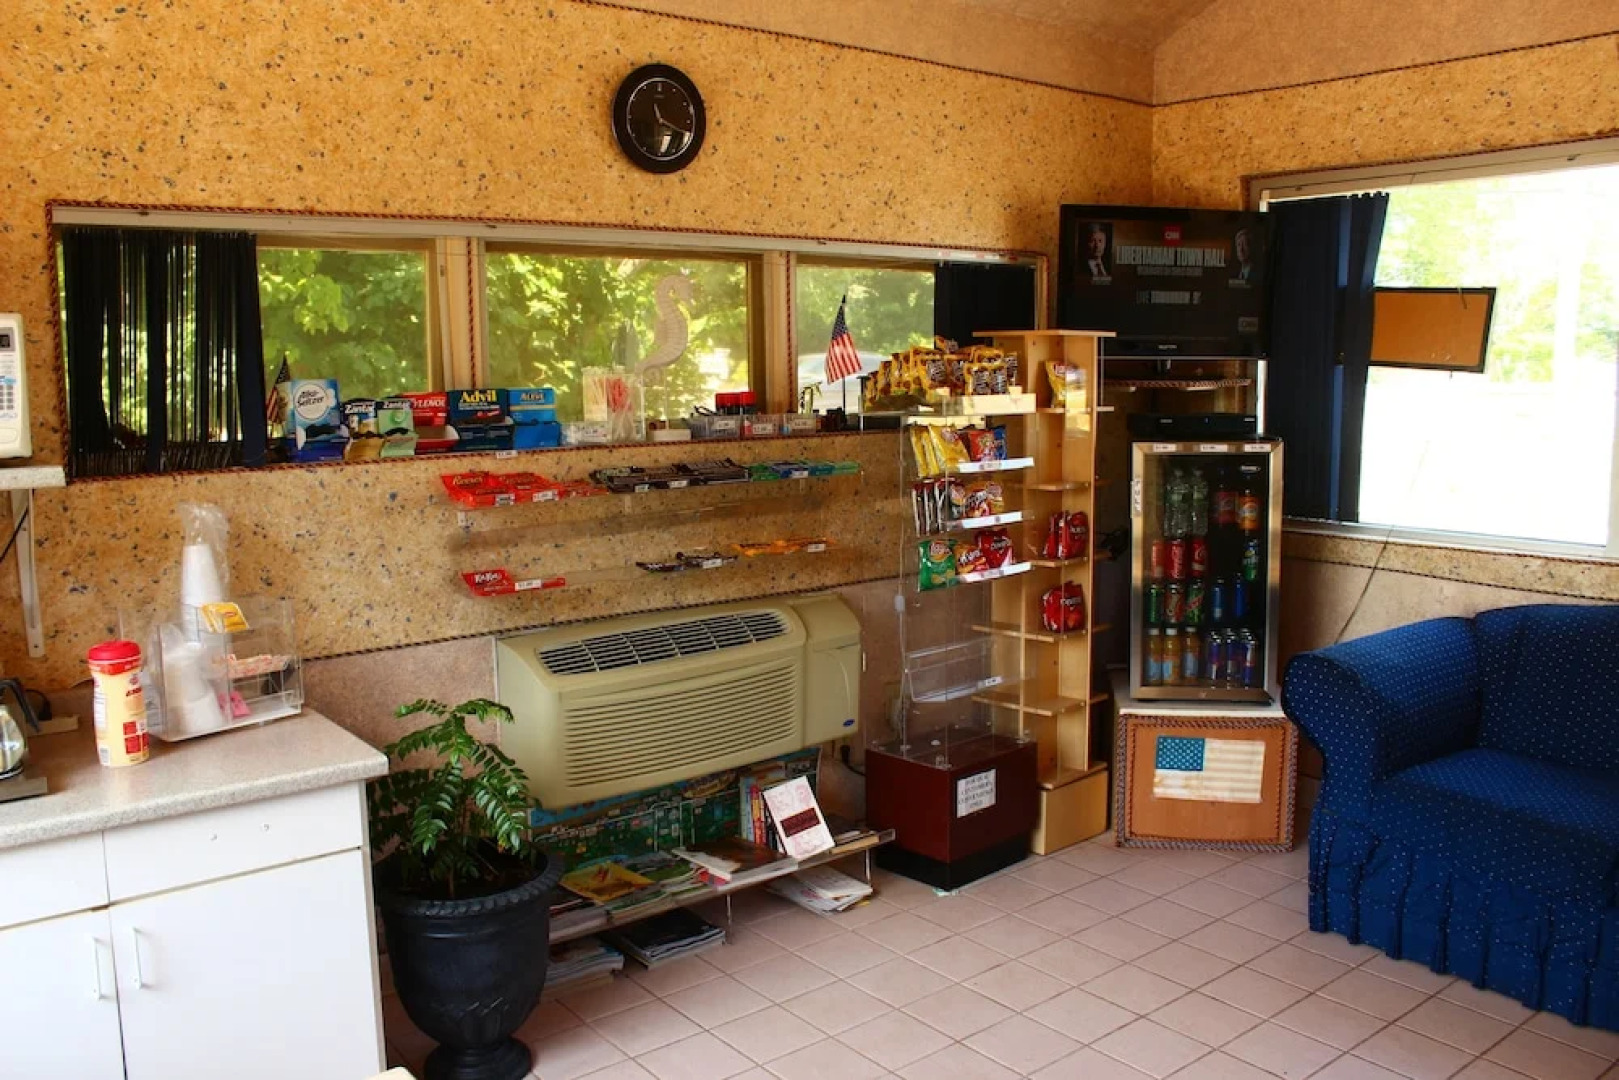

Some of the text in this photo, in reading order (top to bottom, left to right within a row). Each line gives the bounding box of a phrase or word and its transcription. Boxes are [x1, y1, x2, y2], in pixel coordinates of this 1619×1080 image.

[1116, 245, 1226, 268] LIBERTARIAN TOWN HALL
[412, 399, 446, 408] YLENOL
[459, 389, 498, 404] Advil
